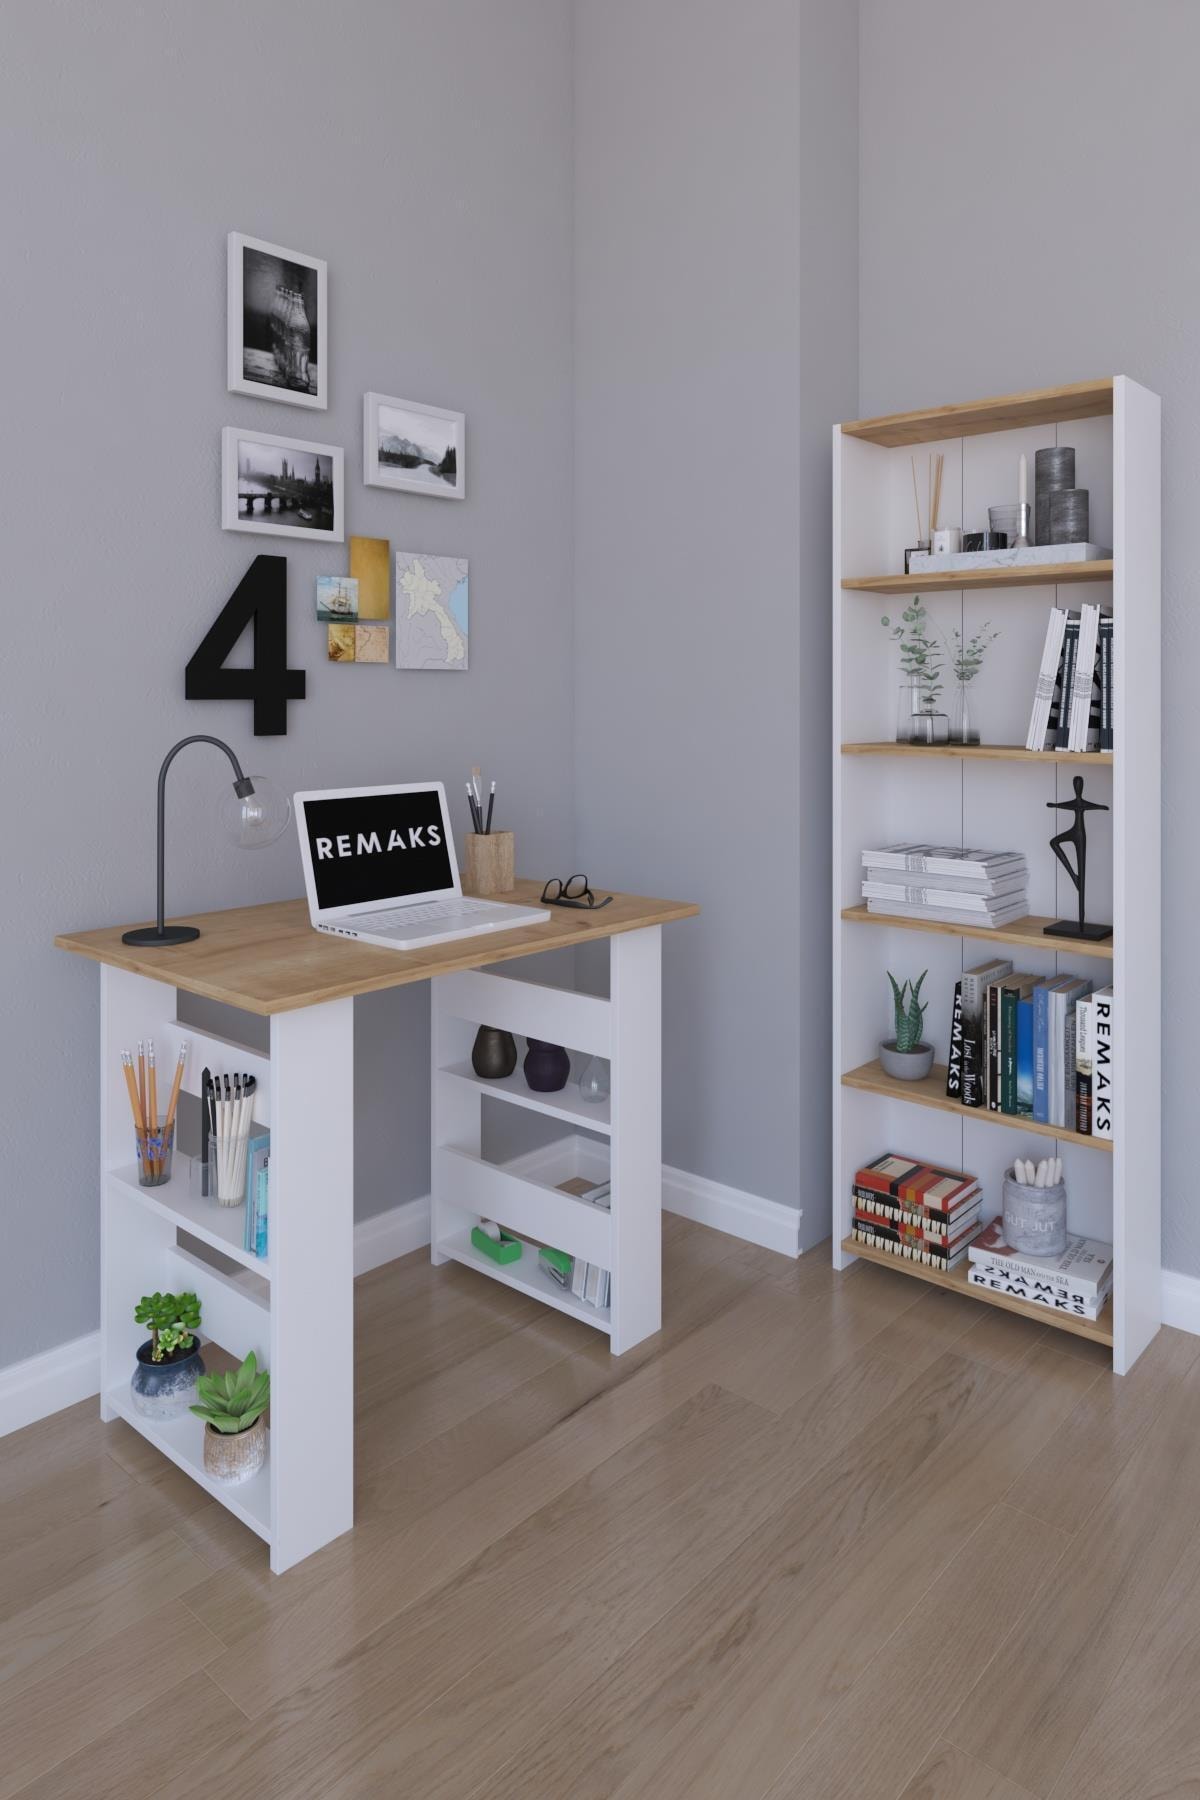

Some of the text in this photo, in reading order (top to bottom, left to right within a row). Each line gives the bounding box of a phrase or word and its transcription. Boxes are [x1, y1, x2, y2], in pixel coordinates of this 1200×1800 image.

[185, 555, 306, 736] 4
[315, 824, 442, 860] REMAKS
[948, 994, 962, 1090] REMAKS
[964, 1038, 976, 1059] Lost
[1096, 1002, 1111, 1132] REMAKS
[963, 1073, 976, 1105] Woods
[990, 1257, 1004, 1267] THE
[1004, 1260, 1020, 1271] OLD
[1021, 1264, 1036, 1276] MAN
[973, 1274, 1085, 1315] REMAKS
